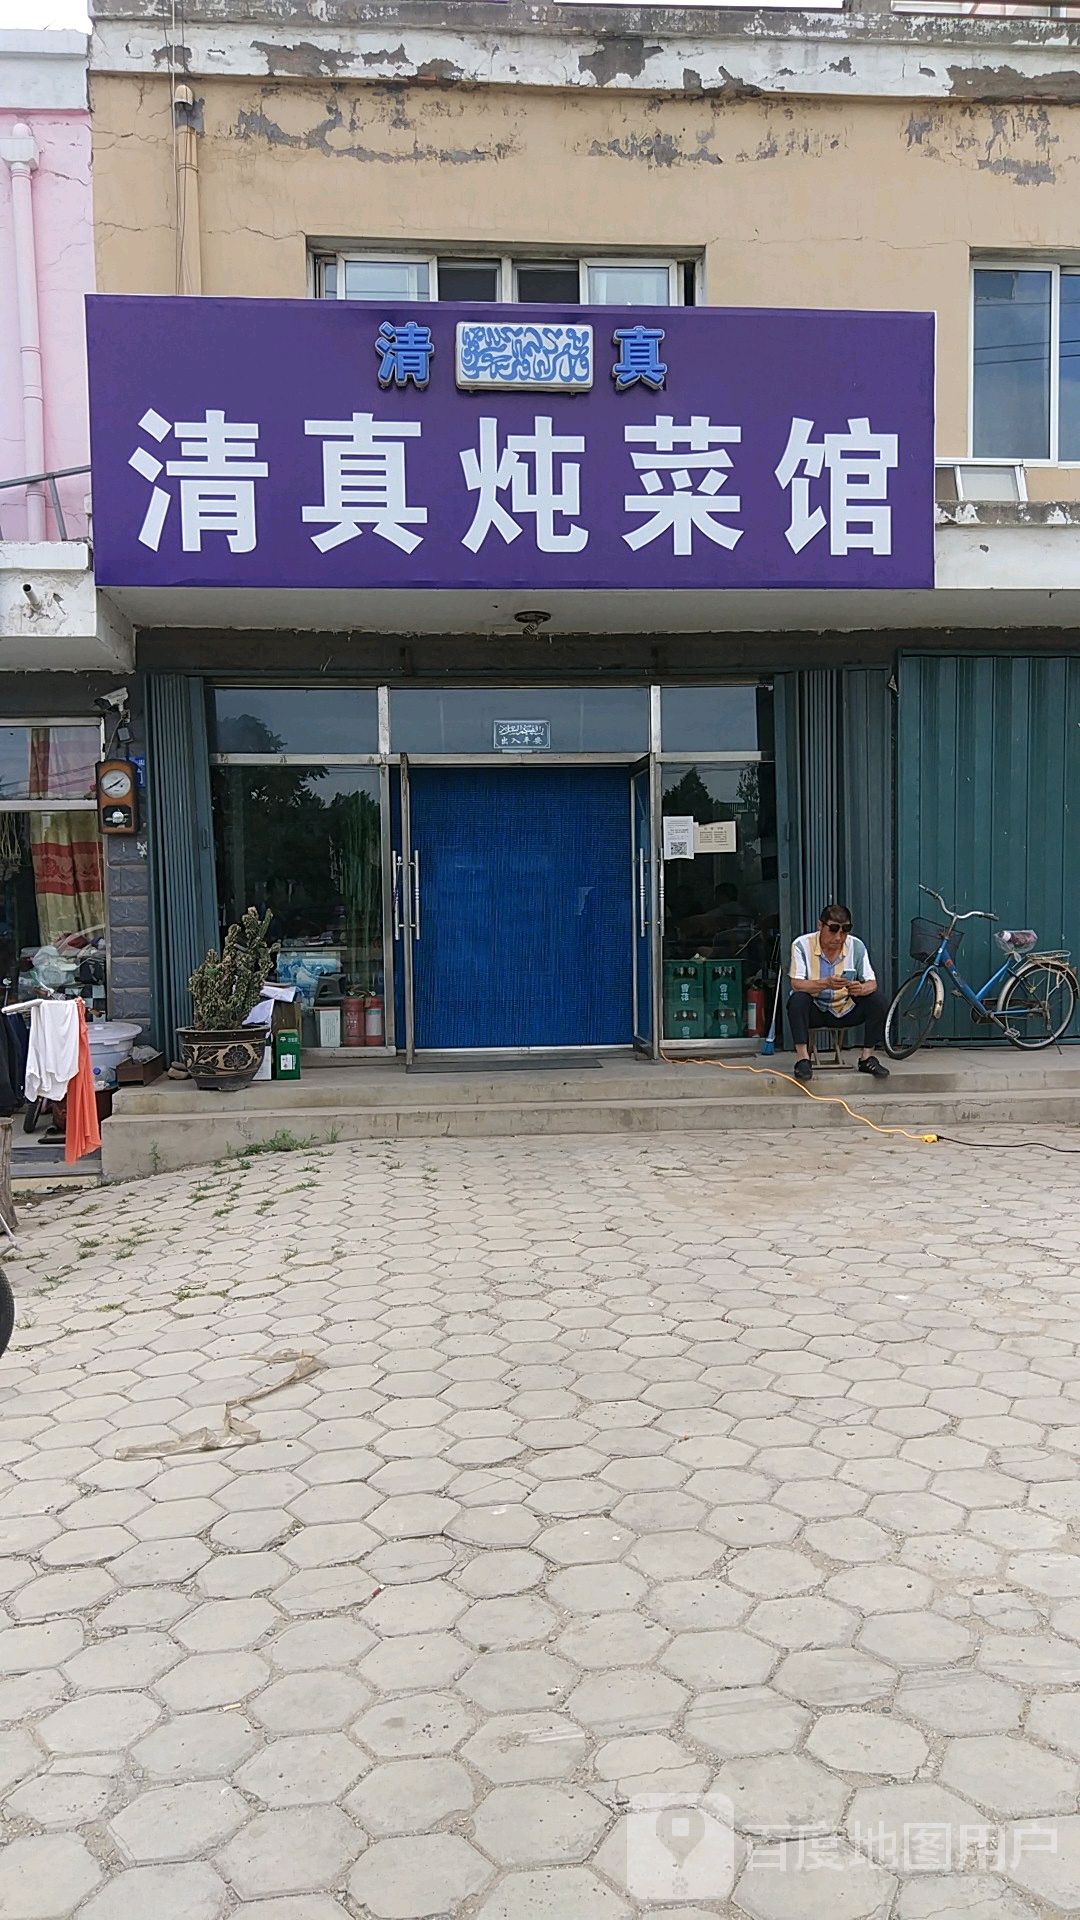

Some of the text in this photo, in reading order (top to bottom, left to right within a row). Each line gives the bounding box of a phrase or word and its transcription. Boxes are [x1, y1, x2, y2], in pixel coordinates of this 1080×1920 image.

[375, 320, 434, 388] 清
[612, 325, 668, 389] 真
[127, 408, 899, 556] 清真炖菜馆
